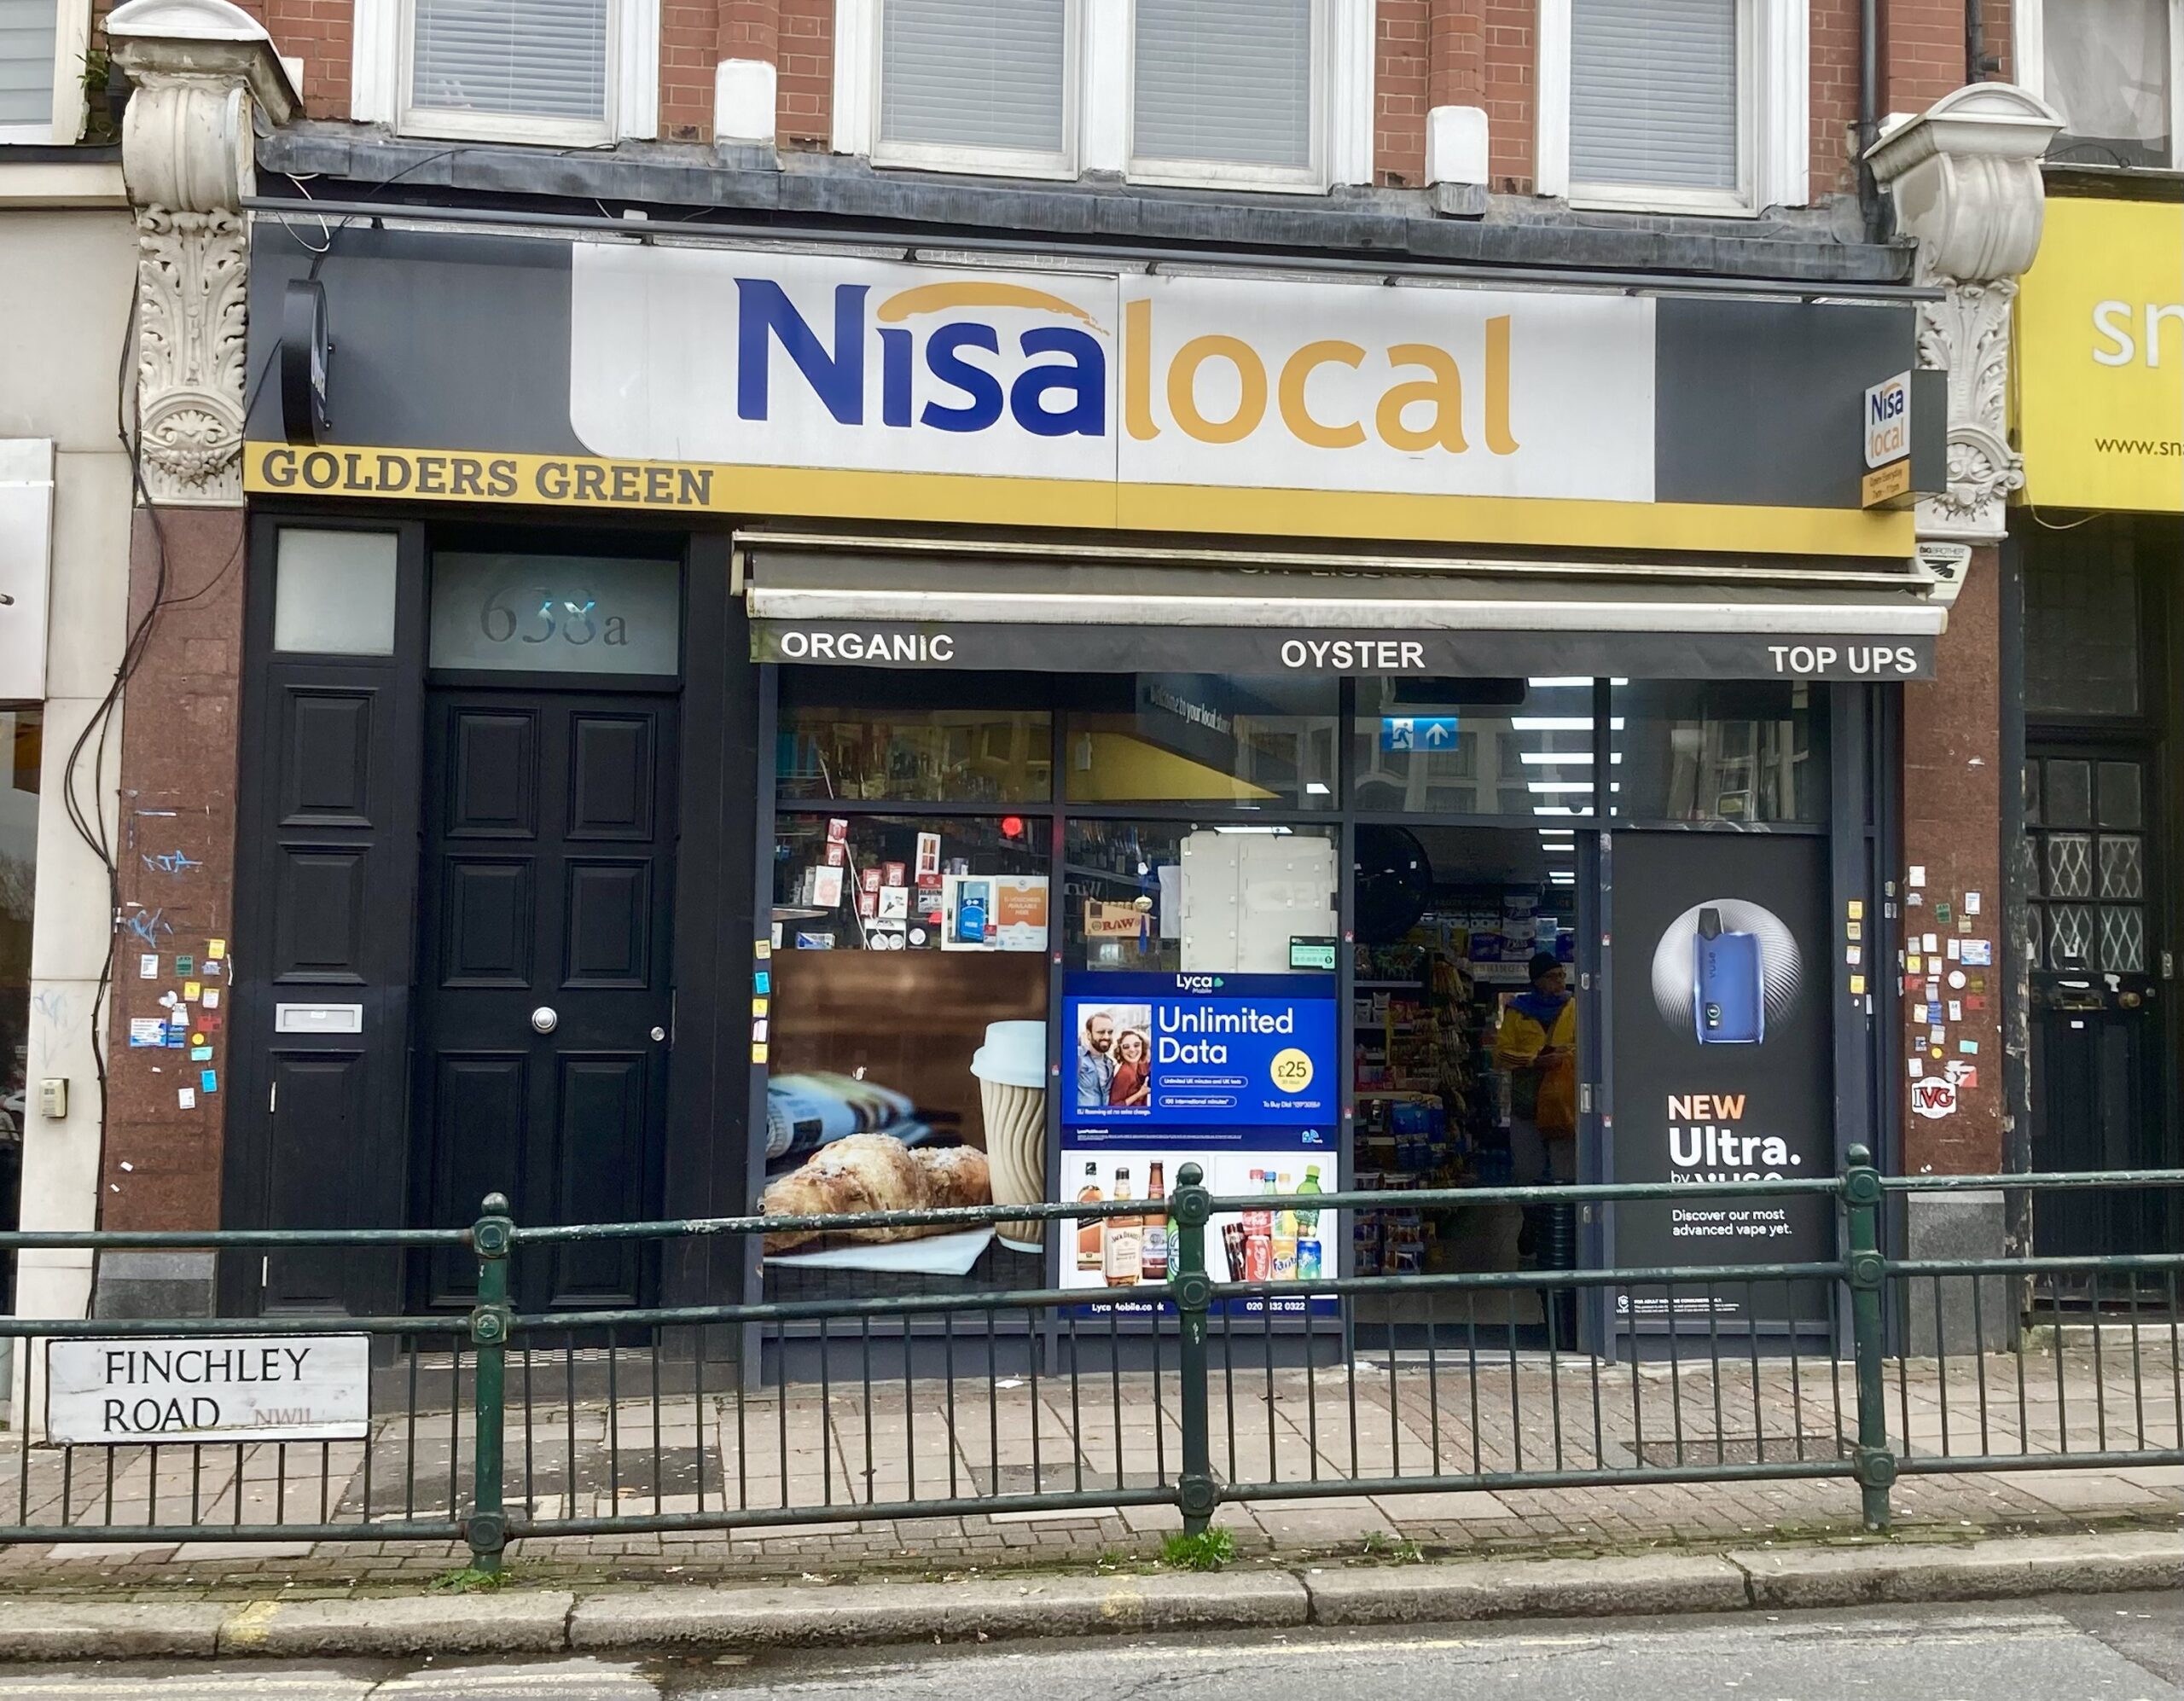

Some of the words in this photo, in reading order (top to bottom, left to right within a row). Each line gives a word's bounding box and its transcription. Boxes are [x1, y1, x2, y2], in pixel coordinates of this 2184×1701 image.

[735, 278, 1107, 438] Nisa
[1124, 298, 1520, 456] local
[1871, 388, 1904, 426] Nisa
[1868, 416, 1904, 461] local
[2094, 438, 2184, 456] www.sn
[262, 449, 518, 497] GOLDERS
[536, 462, 714, 506] GREEN
[479, 585, 630, 647] 638a
[780, 630, 955, 663] ORGANIC
[1281, 639, 1426, 669] OYSTER
[1768, 645, 1838, 674] TOP
[1847, 646, 1918, 674] UPS
[1186, 701, 1201, 723] your
[1201, 702, 1217, 729] local
[1102, 917, 1136, 932] RAW
[1176, 973, 1212, 990] Lyca
[1159, 1006, 1293, 1035] Unlimited
[1159, 1036, 1228, 1064] Data
[1278, 1060, 1307, 1078] £25
[1668, 1094, 1746, 1121] NEW
[1913, 1086, 1955, 1109] IVG
[1668, 1125, 1802, 1167] Ultra.
[1672, 1208, 1727, 1222] Discover
[1728, 1210, 1750, 1221] our
[1752, 1208, 1786, 1221] most
[1672, 1222, 1734, 1236] advanced
[1735, 1225, 1767, 1238] vape
[1769, 1222, 1793, 1238] yet.
[1246, 1302, 1263, 1311] 020
[1284, 1302, 1306, 1311] 0322
[105, 1347, 312, 1385] FINCHLEY
[103, 1396, 221, 1432] ROAD
